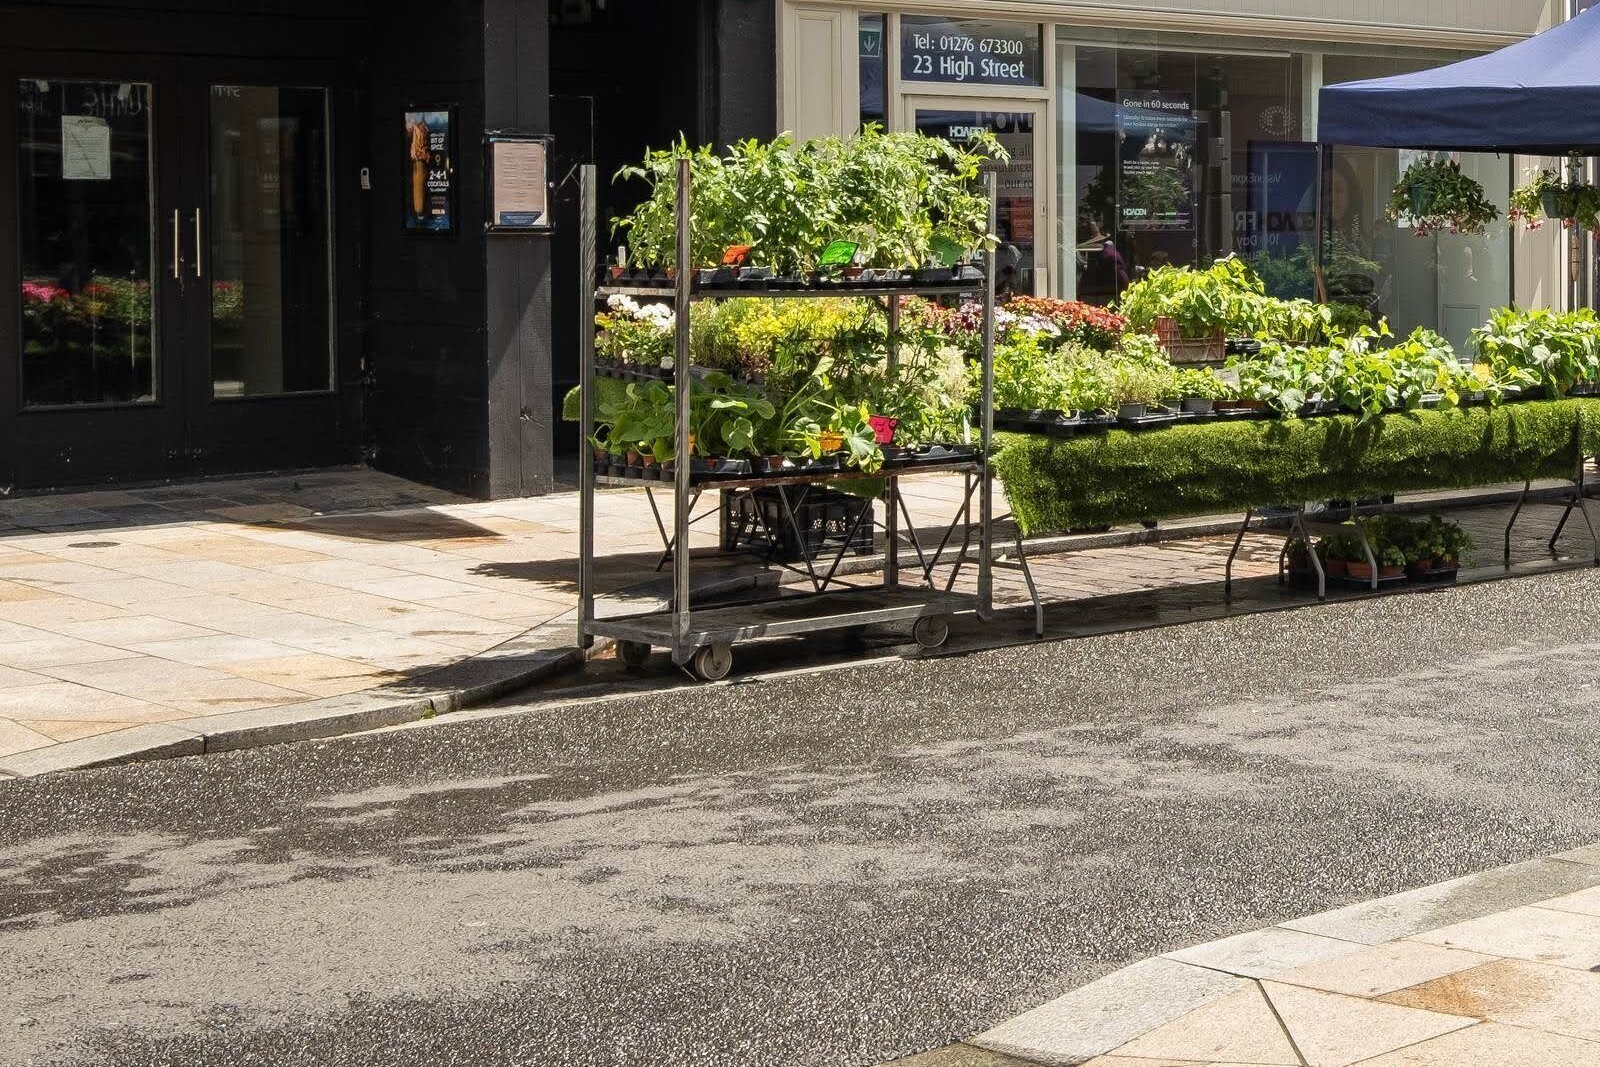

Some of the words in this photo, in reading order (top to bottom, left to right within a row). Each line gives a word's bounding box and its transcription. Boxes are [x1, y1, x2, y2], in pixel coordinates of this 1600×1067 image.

[913, 33, 935, 50] Tel:
[940, 35, 974, 52] 01276
[980, 39, 1023, 55] 673300
[913, 54, 932, 74] 23
[940, 56, 975, 80] High
[981, 58, 1025, 79] Street
[1123, 99, 1142, 108] Gone
[1143, 100, 1149, 109] in
[1151, 101, 1160, 109] 60
[1162, 102, 1189, 110] seconds
